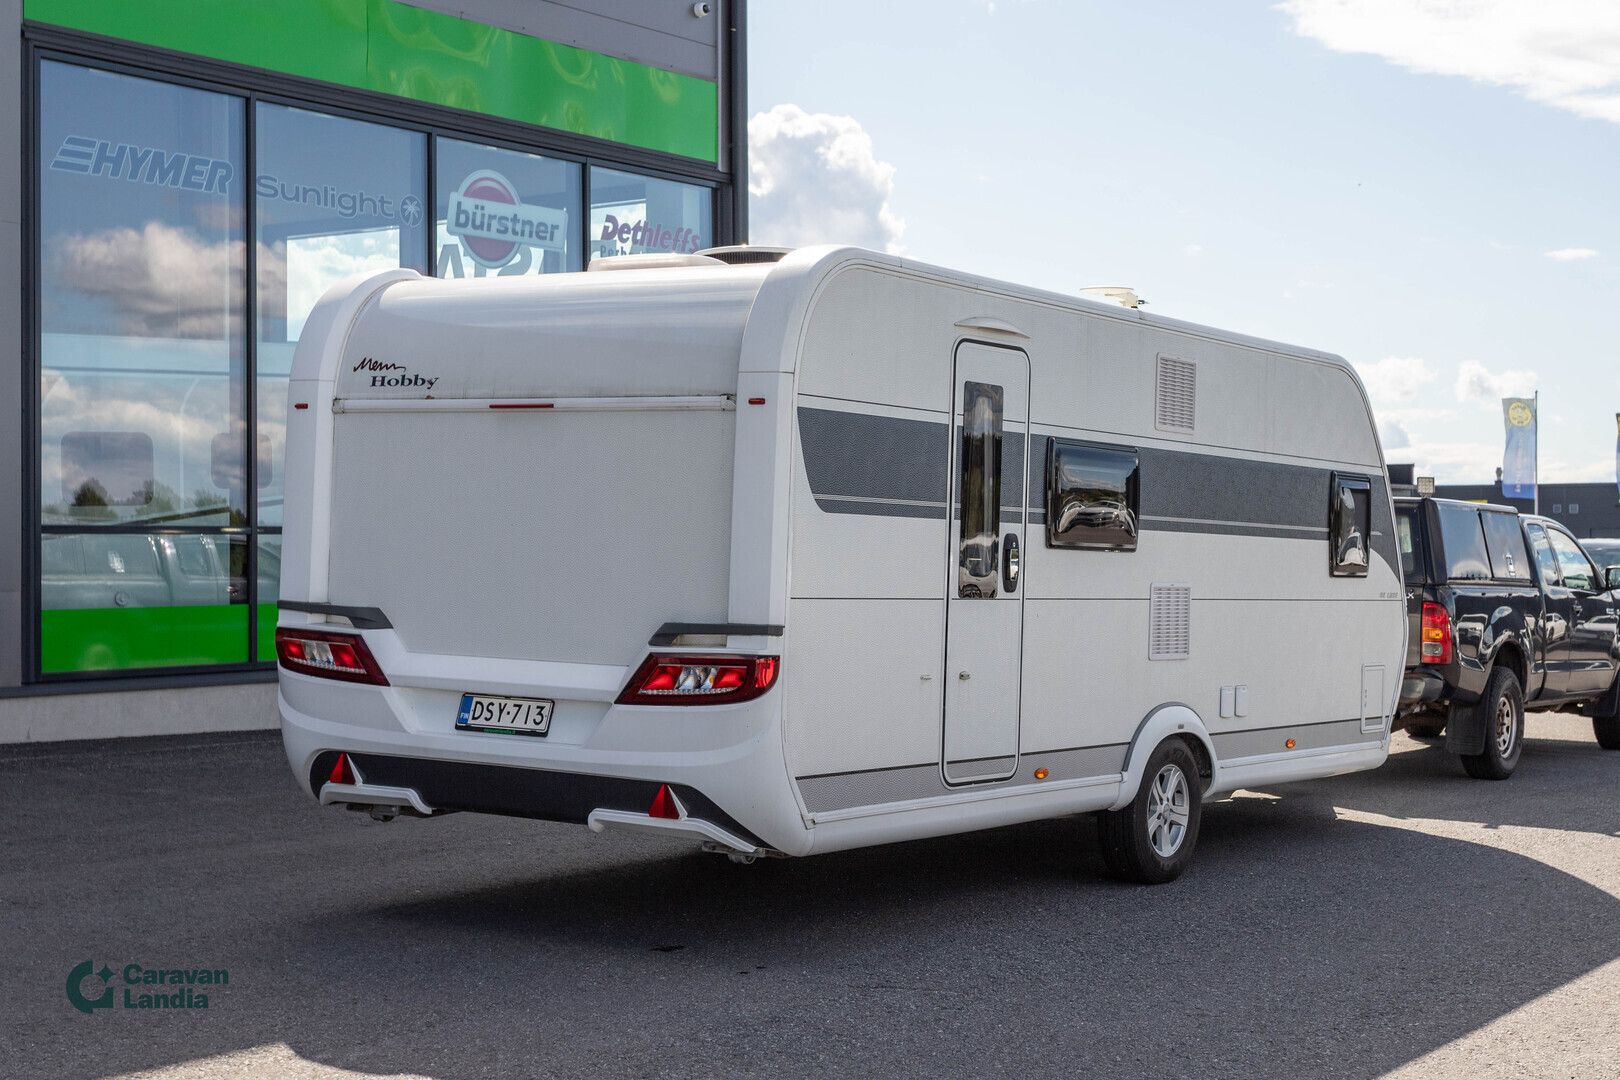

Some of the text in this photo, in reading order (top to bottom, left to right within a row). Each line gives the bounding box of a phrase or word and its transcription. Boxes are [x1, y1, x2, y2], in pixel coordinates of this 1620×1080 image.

[90, 139, 234, 195] HYMER
[256, 174, 395, 219] Sunlight
[454, 200, 560, 242] bürstner
[600, 213, 701, 253] Dethleffs
[370, 373, 440, 390] Hobby
[471, 700, 546, 726] DSY-713
